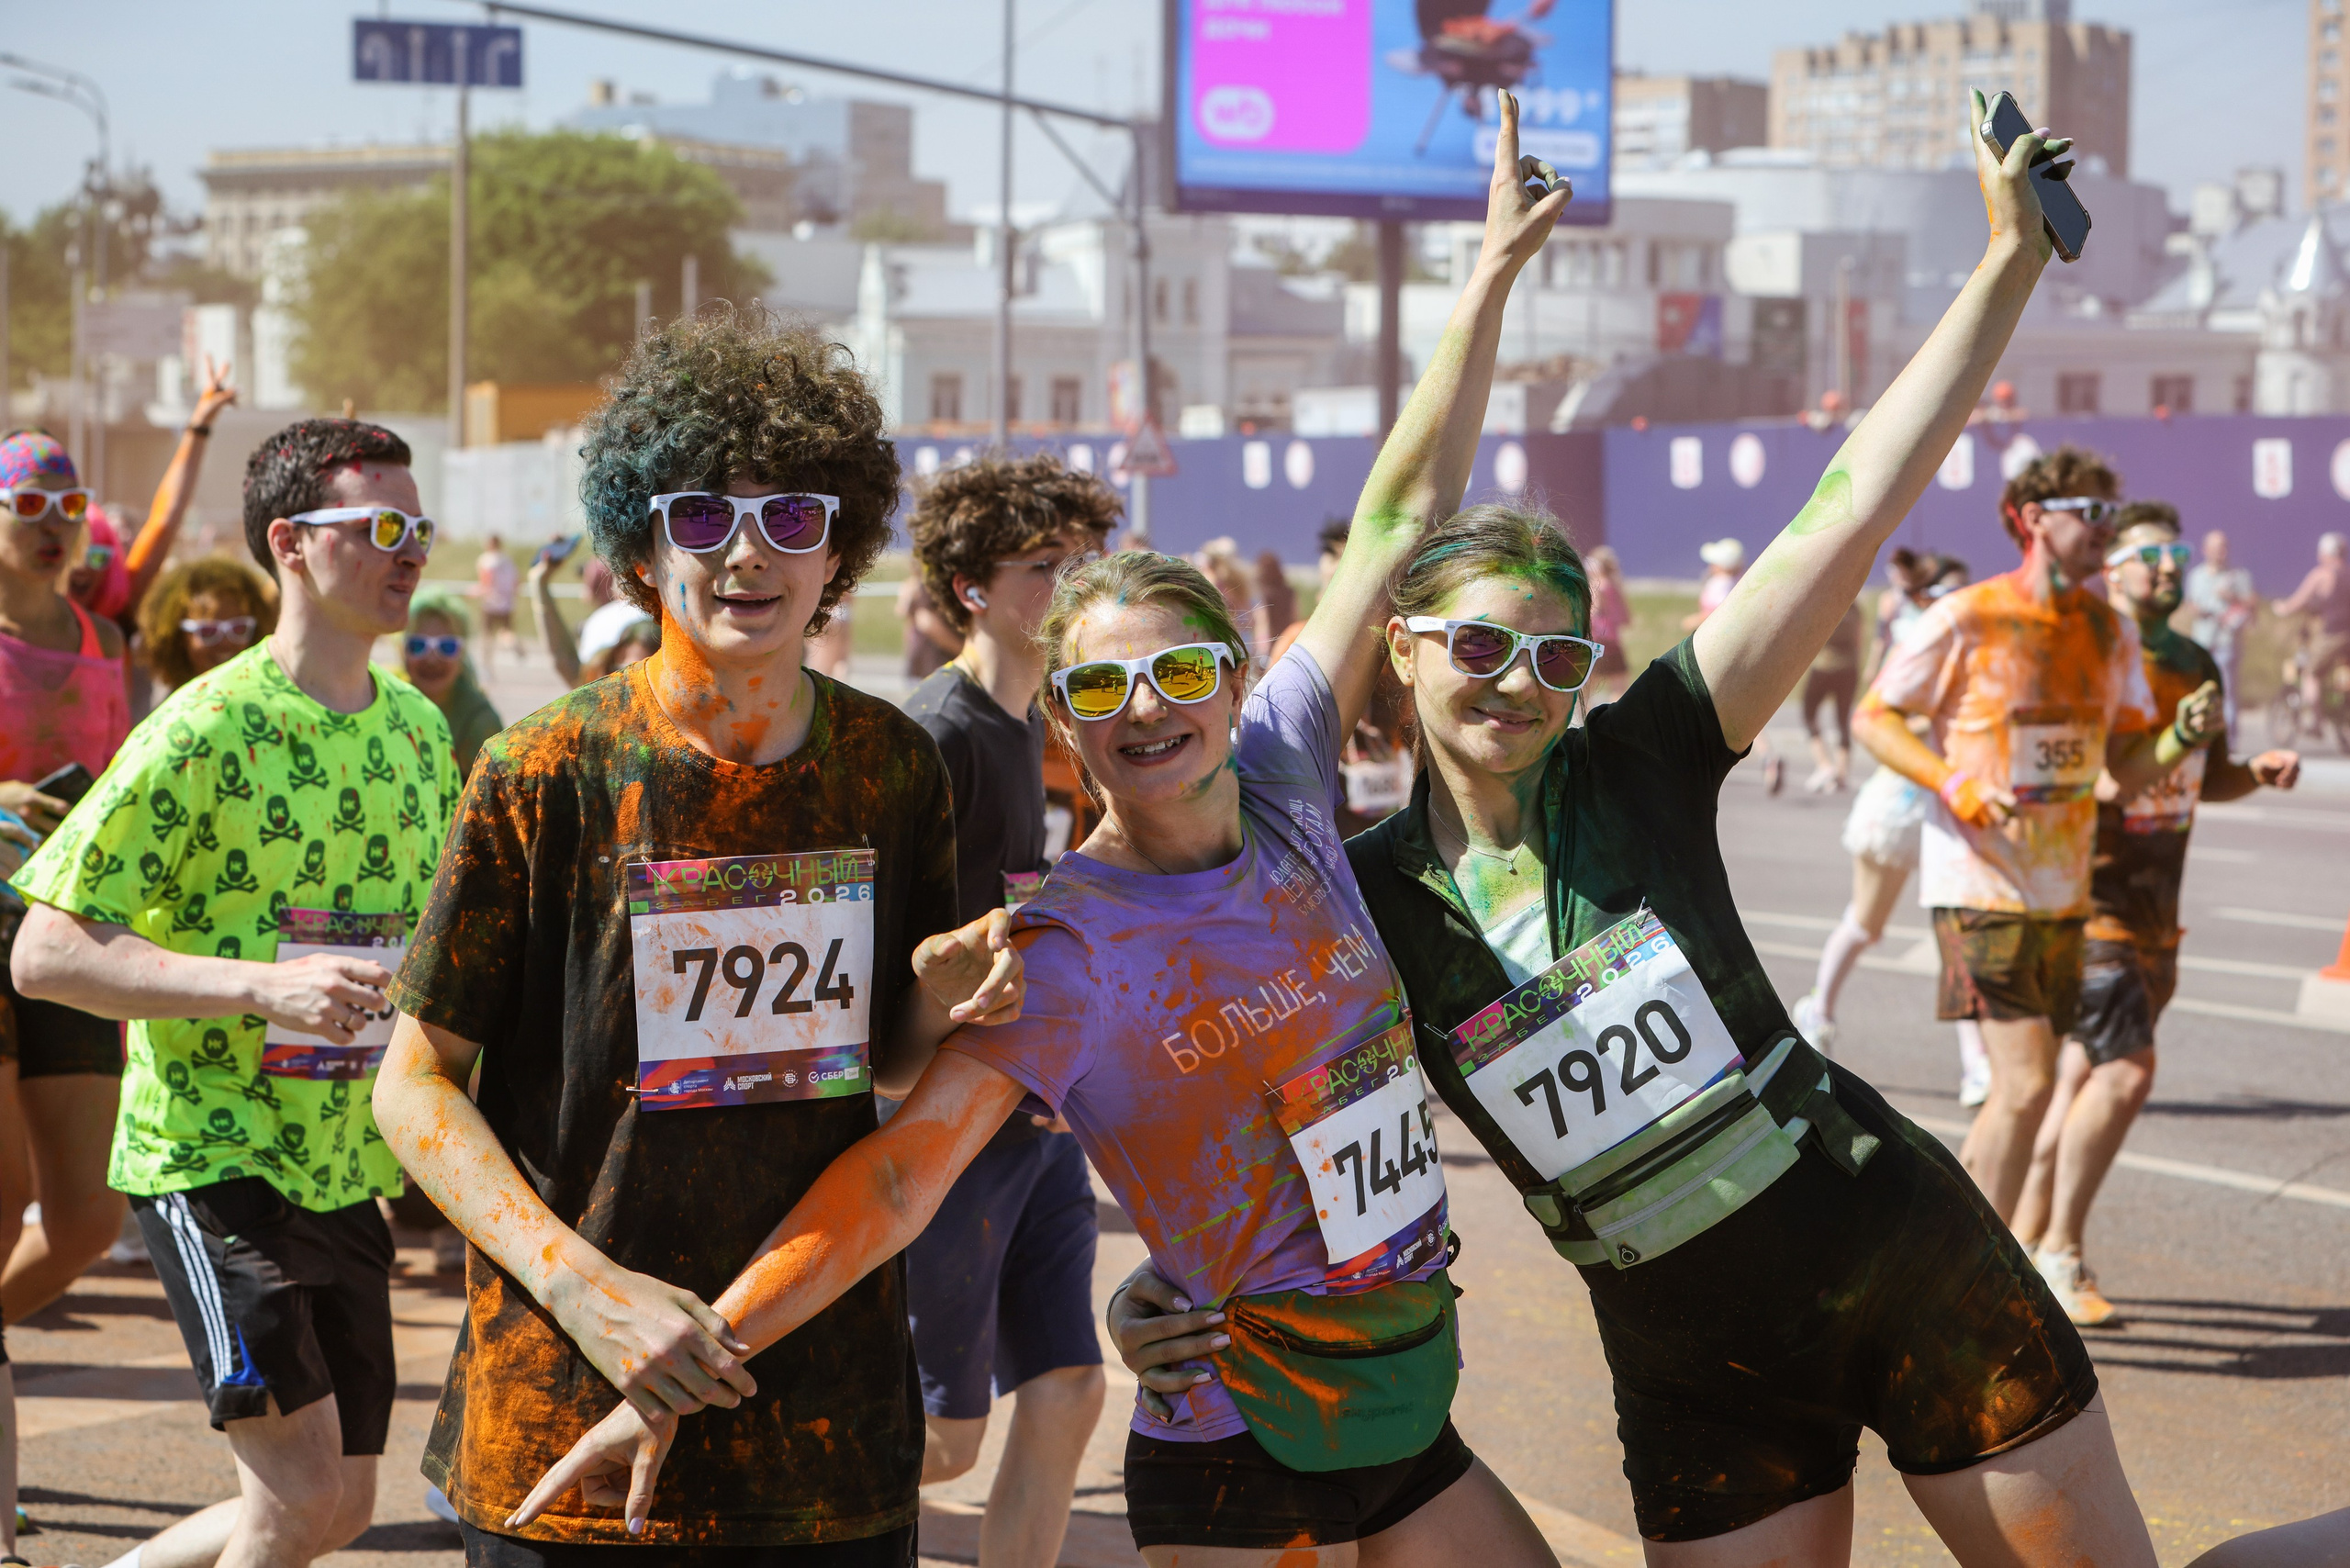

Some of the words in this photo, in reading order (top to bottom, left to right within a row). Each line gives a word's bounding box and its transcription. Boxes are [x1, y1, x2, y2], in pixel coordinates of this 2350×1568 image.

[2035, 740, 2085, 770] 355
[653, 854, 859, 896] КРАСОЧНЫЙ
[655, 894, 767, 910] ЗАБЕГ
[780, 884, 871, 906] 2026
[672, 938, 855, 1022] 7924
[1162, 969, 1326, 1073] БОЛЬШЕ,
[1313, 923, 1378, 981] ЧЕМ
[1461, 923, 1647, 1053] КРАСОЧНЫЙ
[1477, 1000, 1566, 1064] ЗАБЕГ
[1576, 935, 1671, 1004] 2026
[737, 1071, 773, 1083] МОСКОВСКИЙ
[737, 1082, 755, 1091] СПОРТ
[821, 1070, 844, 1081] СБЕР
[1386, 1055, 1416, 1084] 20
[1513, 999, 1693, 1140] 7920
[1332, 1101, 1438, 1217] 7445
